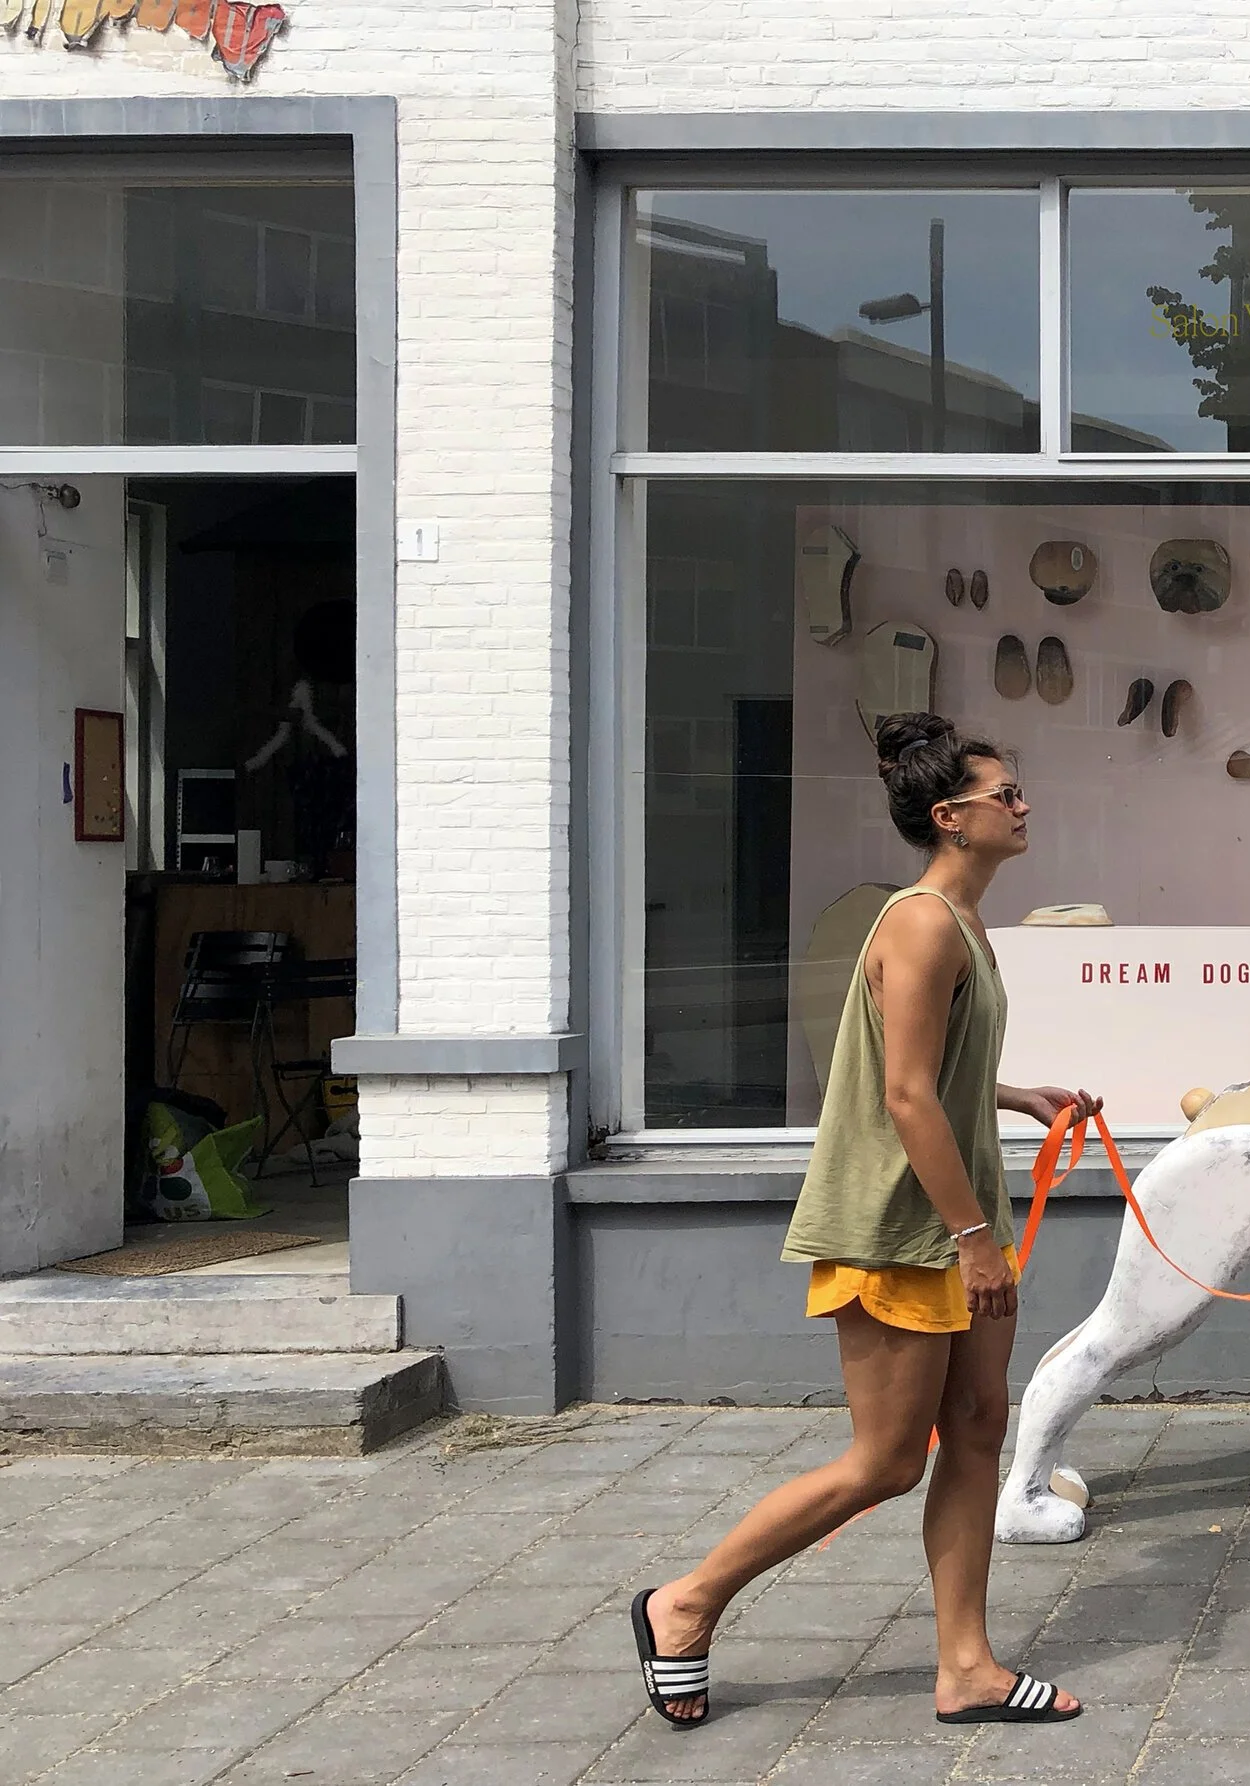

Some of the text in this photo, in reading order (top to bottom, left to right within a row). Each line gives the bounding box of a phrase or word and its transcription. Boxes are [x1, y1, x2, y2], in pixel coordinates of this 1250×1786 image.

[1150, 303, 1240, 339] Salon
[415, 528, 424, 557] 1
[1081, 962, 1171, 984] DREAM
[1203, 963, 1250, 984] DOG
[643, 1660, 656, 1694] adidas
